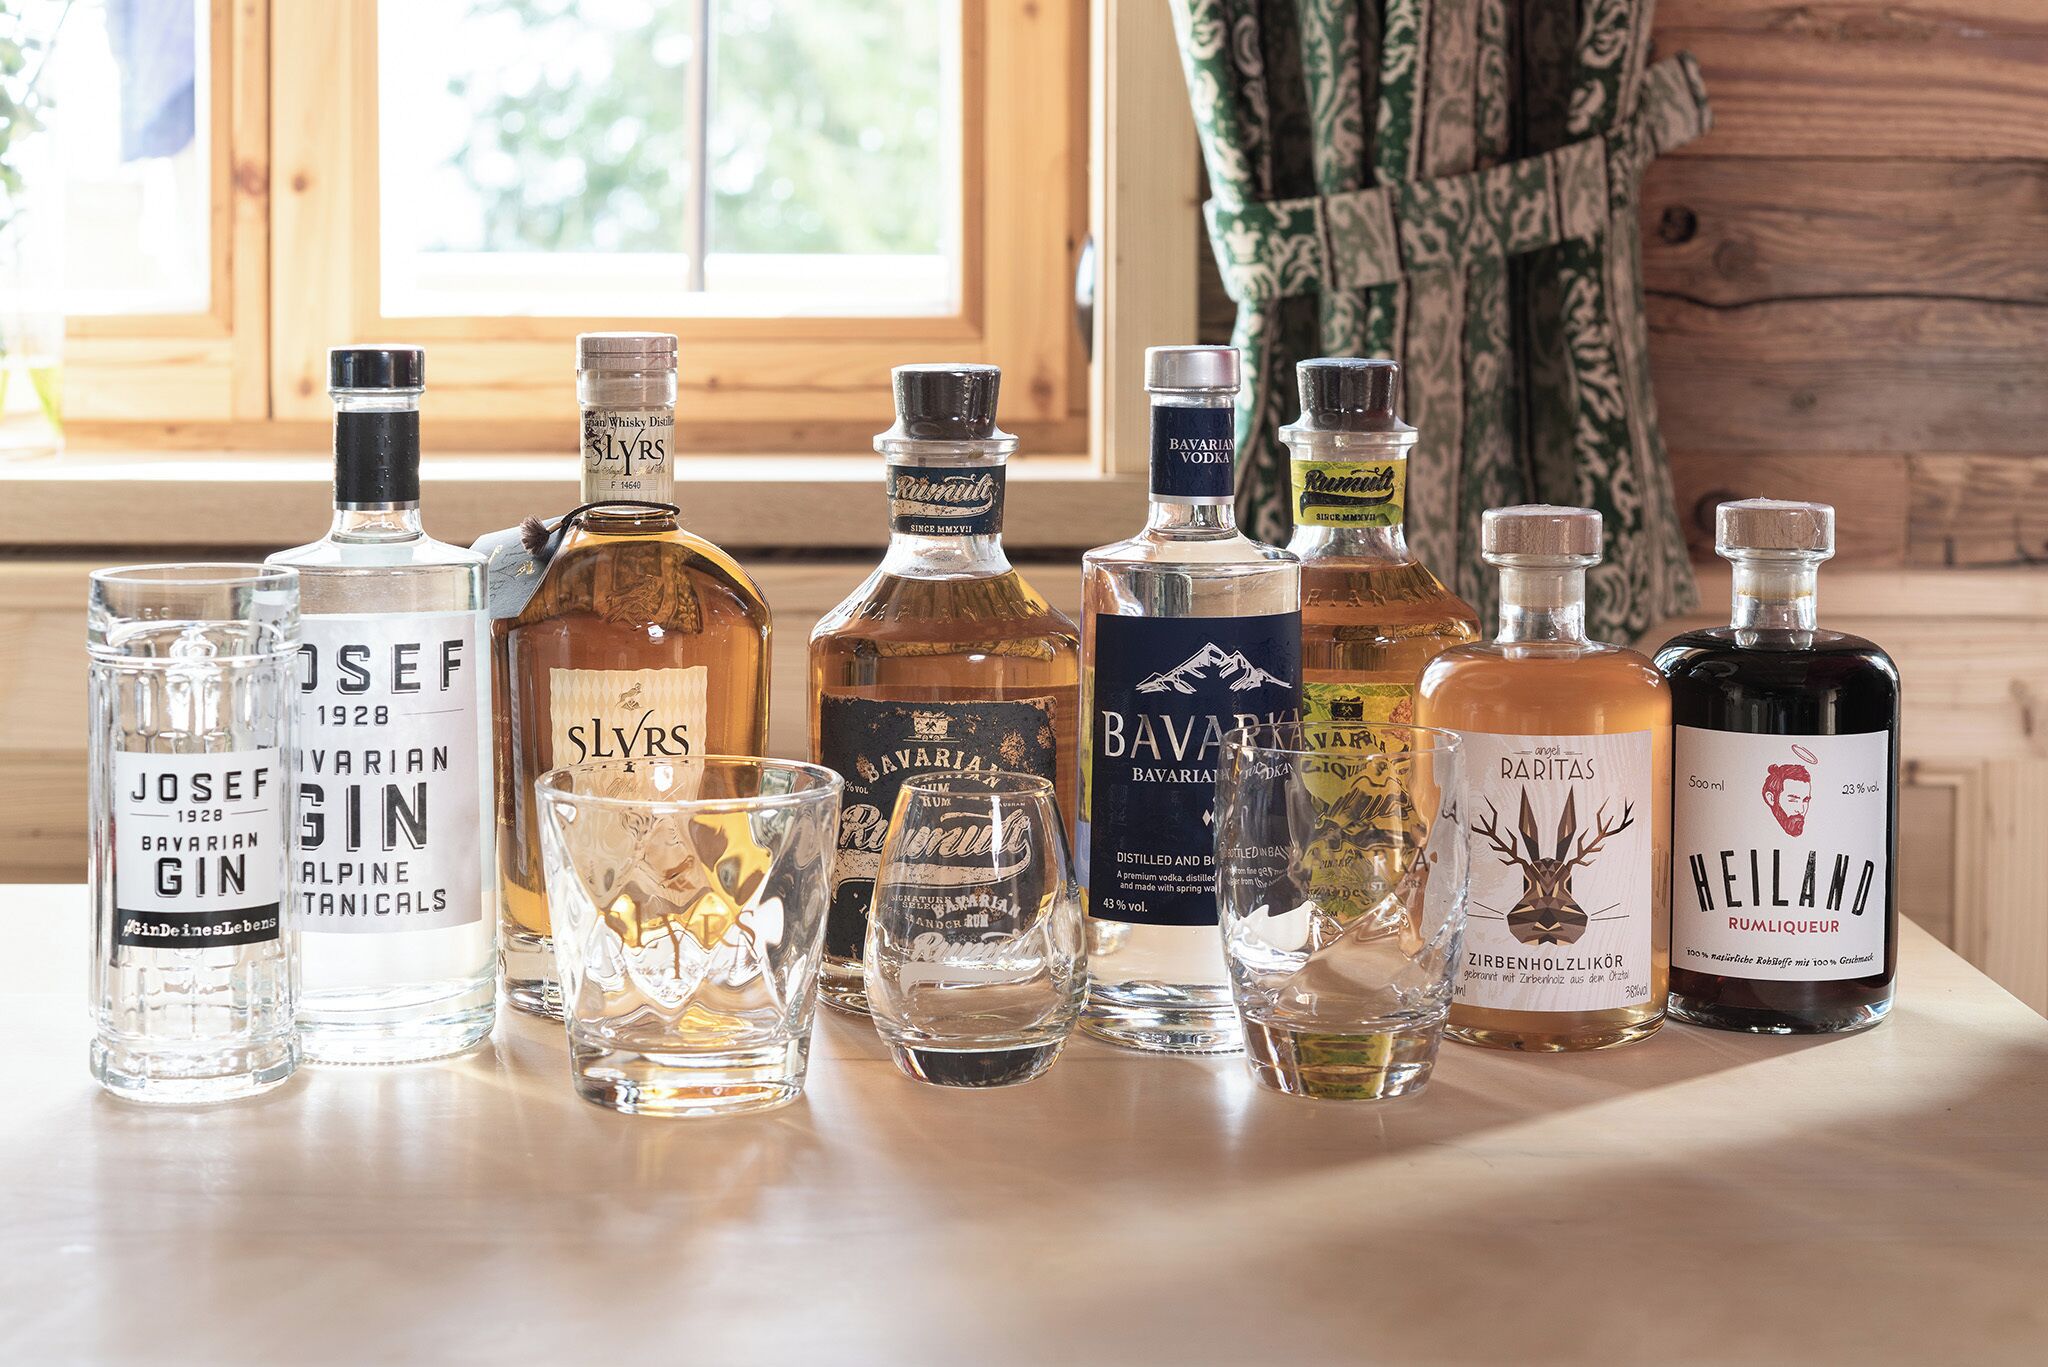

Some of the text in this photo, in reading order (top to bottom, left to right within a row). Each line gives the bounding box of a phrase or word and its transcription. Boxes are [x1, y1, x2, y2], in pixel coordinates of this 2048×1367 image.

[609, 416, 646, 429] Whisky
[592, 429, 665, 477] SLYRS
[1169, 438, 1235, 450] BAVARIAN
[1180, 452, 1229, 463] VODKA
[611, 481, 616, 489] F
[896, 473, 994, 503] Rumult
[1305, 466, 1395, 493] Rumult
[1316, 513, 1376, 521] SINCE MMXVII
[911, 525, 972, 533] SINCE MMXVII
[298, 639, 464, 696] OSEF
[318, 704, 390, 726] 1928
[568, 709, 690, 773] SLYRS
[299, 744, 448, 776] VARIAN
[1535, 745, 1560, 759] angeli
[865, 748, 1003, 789] BAVARIAN
[1501, 756, 1595, 781] RARITAS
[130, 767, 269, 803] JOSEF
[1689, 775, 1725, 791] 500 ml
[1842, 784, 1855, 795] 23
[1857, 782, 1865, 793] %
[178, 809, 223, 823] 1928
[299, 781, 428, 852] GIN
[141, 832, 258, 852] BAVARIAN
[1117, 852, 1172, 866] DISTILLED
[1175, 856, 1200, 866] AND
[155, 853, 246, 898] GIN
[302, 861, 410, 885] ALPINE
[1116, 870, 1122, 878] A
[1123, 872, 1157, 883] premium
[1689, 849, 1875, 916] HEILAND
[1135, 882, 1156, 891] made
[1158, 884, 1174, 892] with
[1176, 885, 1202, 895] spring
[302, 888, 447, 916] TANICALS
[1103, 898, 1148, 912] 43 % vol.
[121, 915, 277, 938] #GinDeinesLebens
[1729, 917, 1840, 936] RUMLIQUEUR
[1468, 953, 1623, 971] ZIRBENHOLZLIKÖR
[1795, 958, 1810, 967] mit
[1464, 970, 1498, 982] gebrannt
[1502, 972, 1515, 983] mit
[1520, 972, 1565, 984] Zirbenholz
[1570, 975, 1584, 984] aus
[1589, 971, 1604, 983] dem
